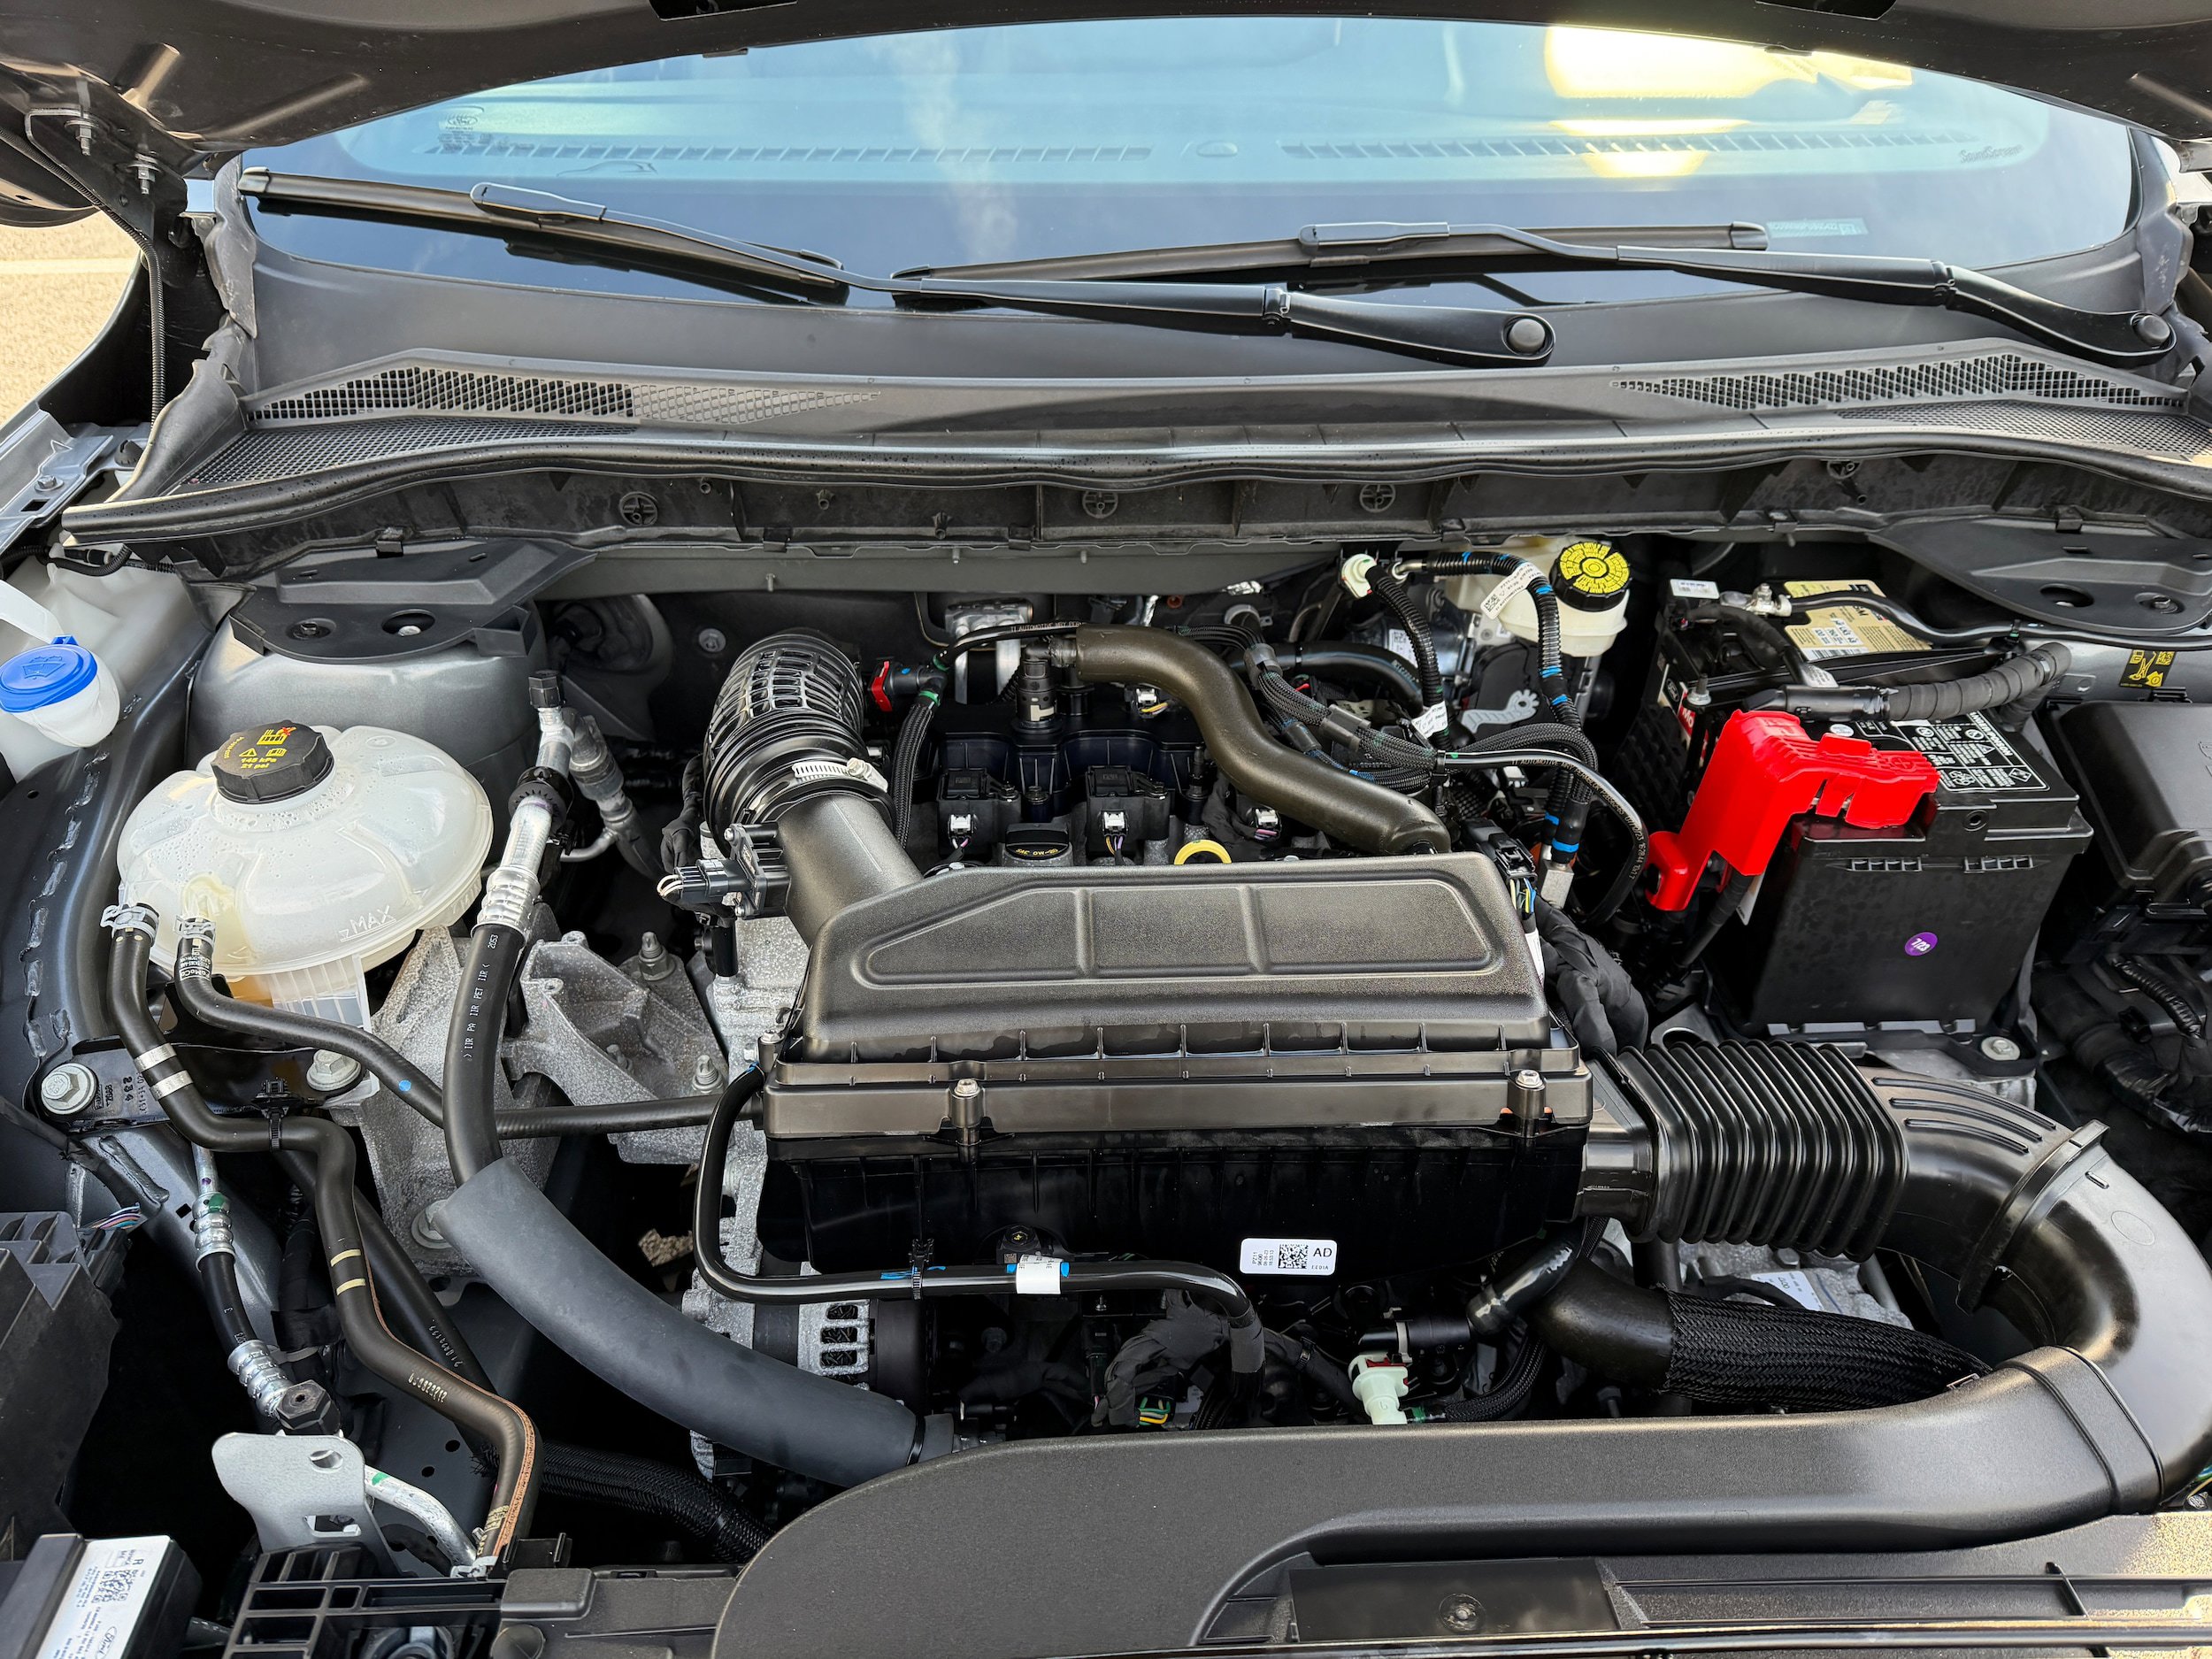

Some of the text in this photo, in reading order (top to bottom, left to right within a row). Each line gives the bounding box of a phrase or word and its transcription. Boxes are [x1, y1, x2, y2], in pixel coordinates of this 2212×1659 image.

[349, 905, 396, 935] MAX
[488, 934, 499, 949] 2053
[473, 987, 484, 1000] PET
[1313, 1248, 1333, 1257] AD
